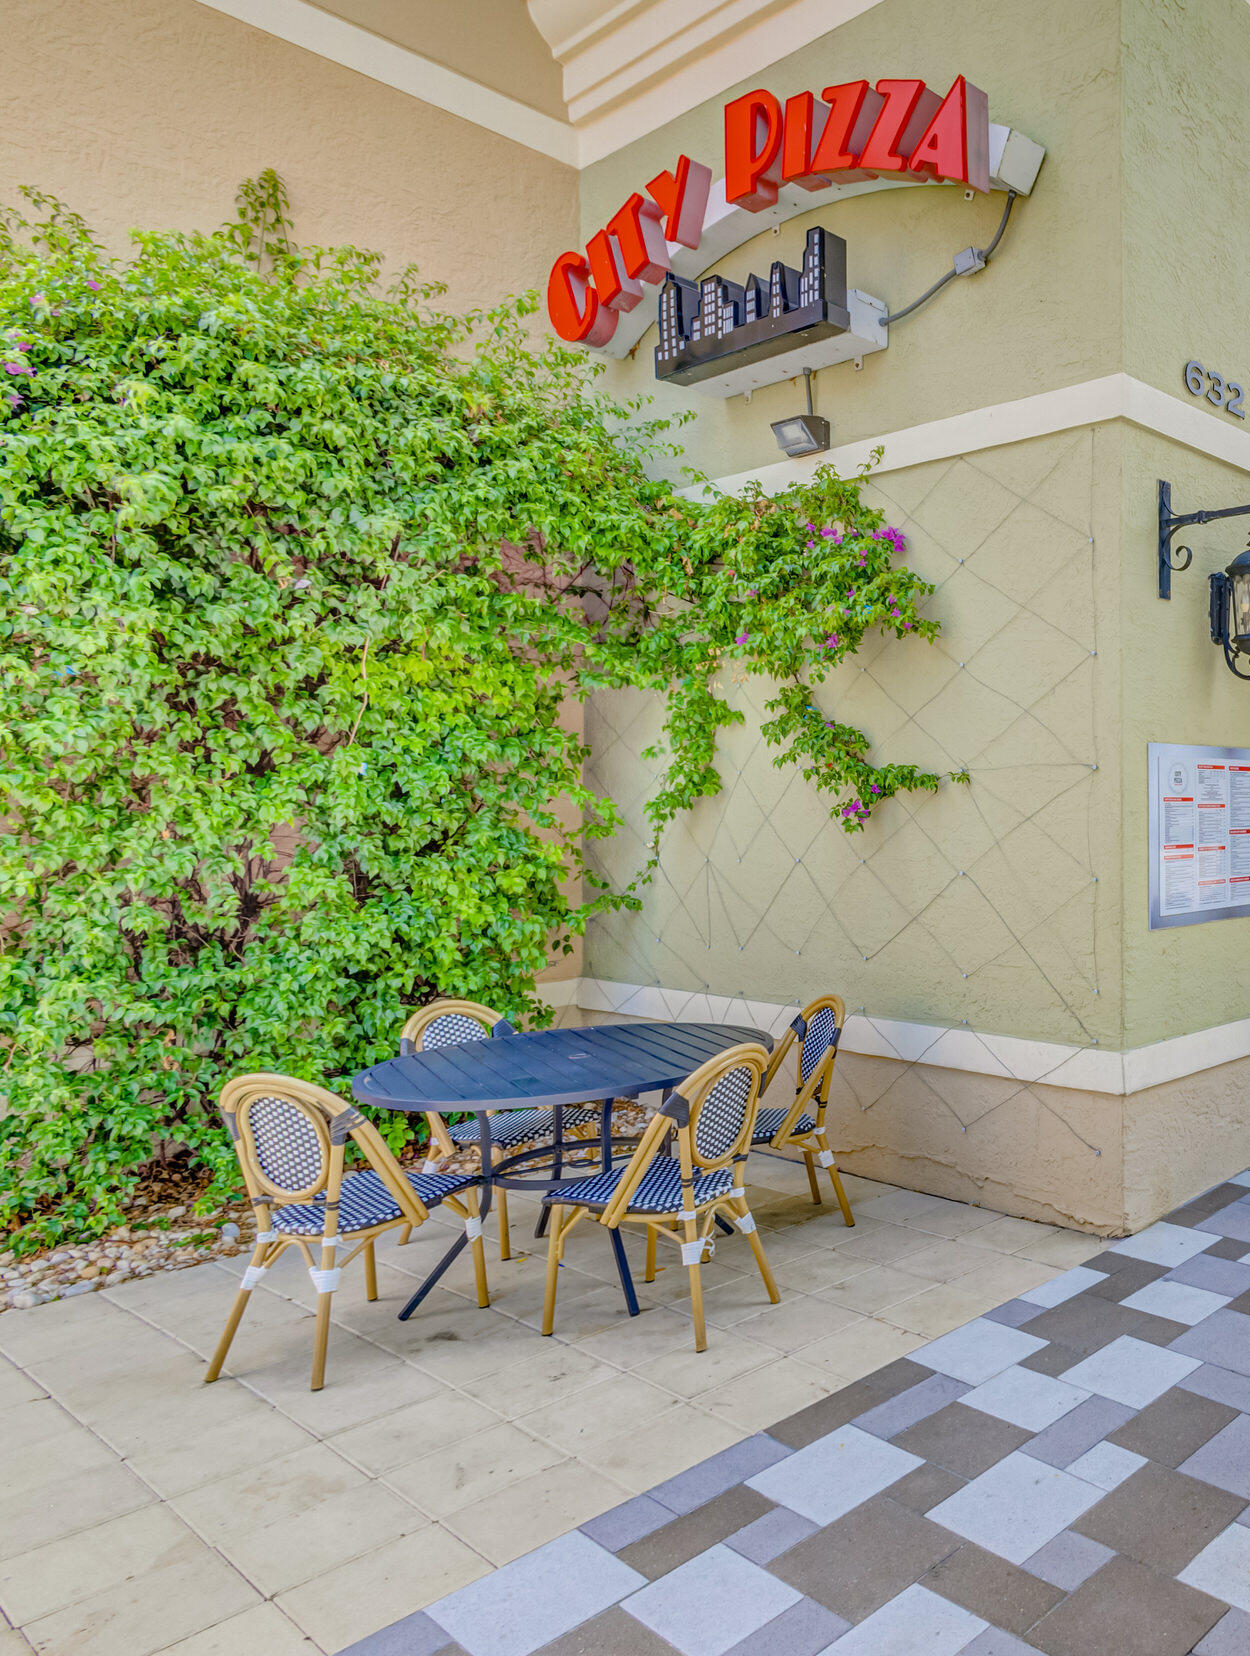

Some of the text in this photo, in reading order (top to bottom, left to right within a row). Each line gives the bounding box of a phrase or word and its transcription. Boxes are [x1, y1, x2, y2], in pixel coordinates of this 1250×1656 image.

[548, 74, 970, 343] CITY PIZZA
[1184, 360, 1246, 420] 632
